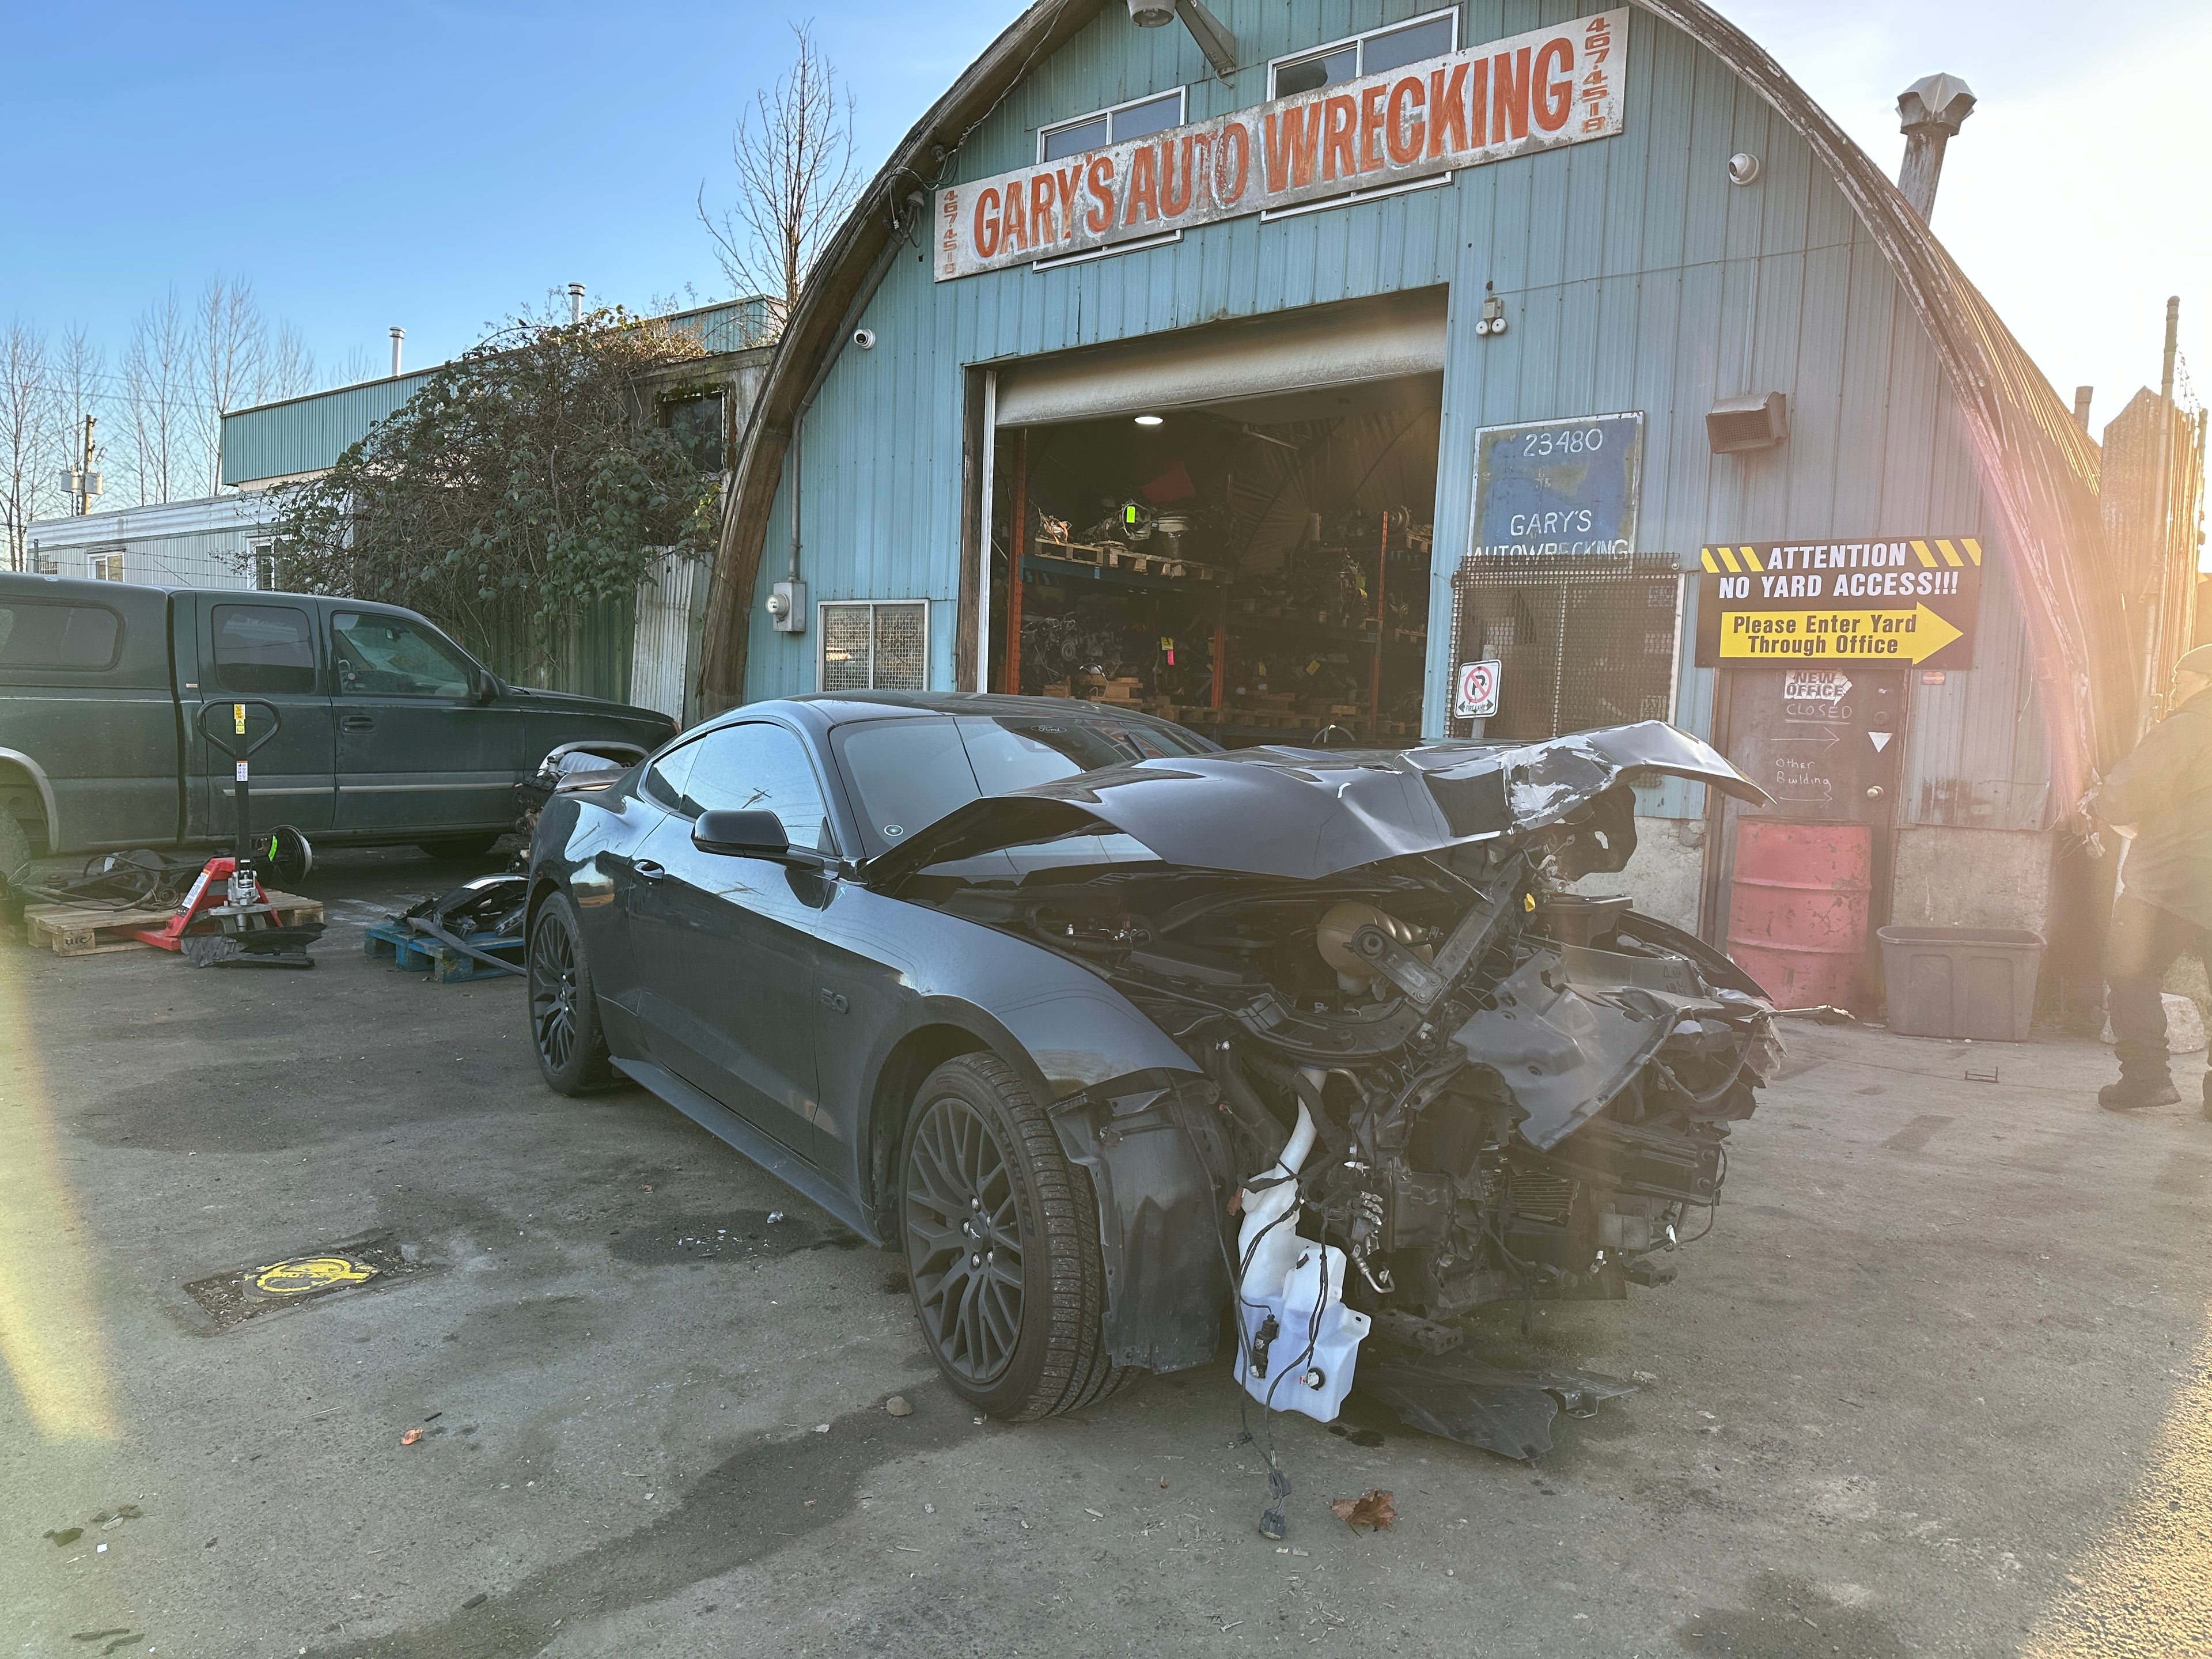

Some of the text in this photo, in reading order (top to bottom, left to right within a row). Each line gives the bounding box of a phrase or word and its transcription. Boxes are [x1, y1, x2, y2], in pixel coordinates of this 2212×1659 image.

[974, 37, 1574, 258] GARY'S AUTO WRECKING
[1523, 428, 1603, 457] 23480
[1510, 509, 1592, 536] GARY'S
[1767, 542, 1907, 570] ATTENTION
[1718, 571, 1959, 599] NO YARD ACCESS!!!
[1733, 613, 1917, 634] Please Enter Yard
[1748, 634, 1899, 657] Through Office
[1794, 670, 1835, 684] NEW
[1786, 683, 1844, 697] OFFICE
[1786, 703, 1853, 718] CLOSED
[1777, 771, 1832, 793] Building
[1000, 1131, 1035, 1237] MICHELIN
